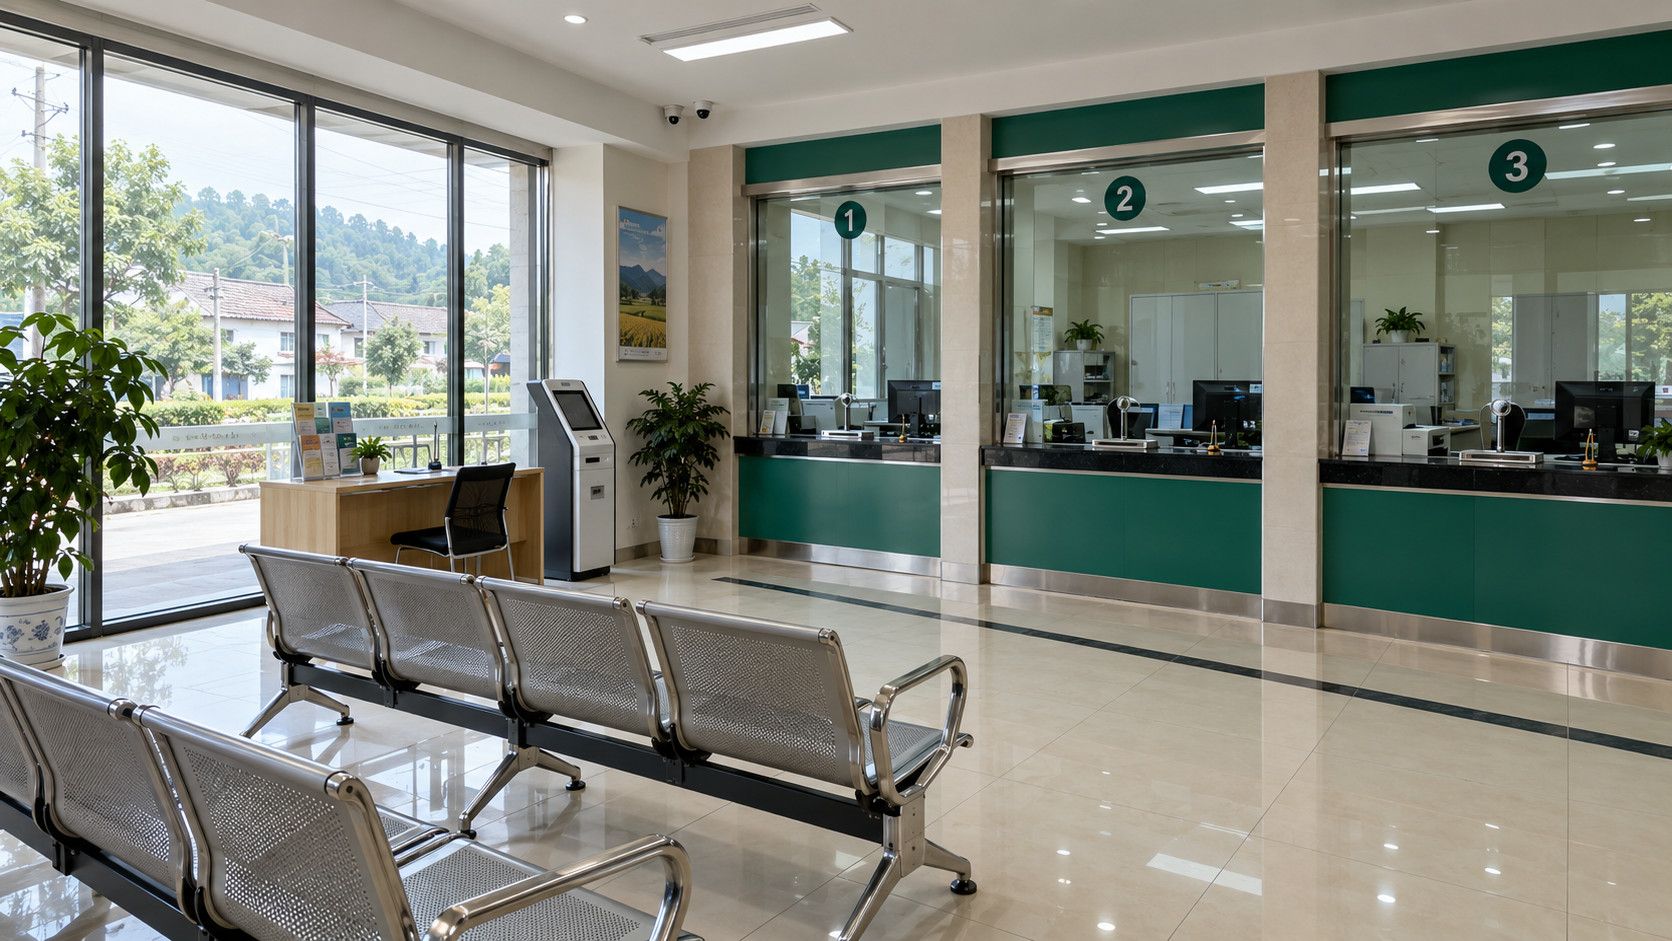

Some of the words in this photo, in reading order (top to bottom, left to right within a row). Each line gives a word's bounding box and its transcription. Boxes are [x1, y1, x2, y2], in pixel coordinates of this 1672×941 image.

[1505, 150, 1529, 182] 3
[1116, 185, 1133, 212] 2
[844, 209, 854, 232] 1
